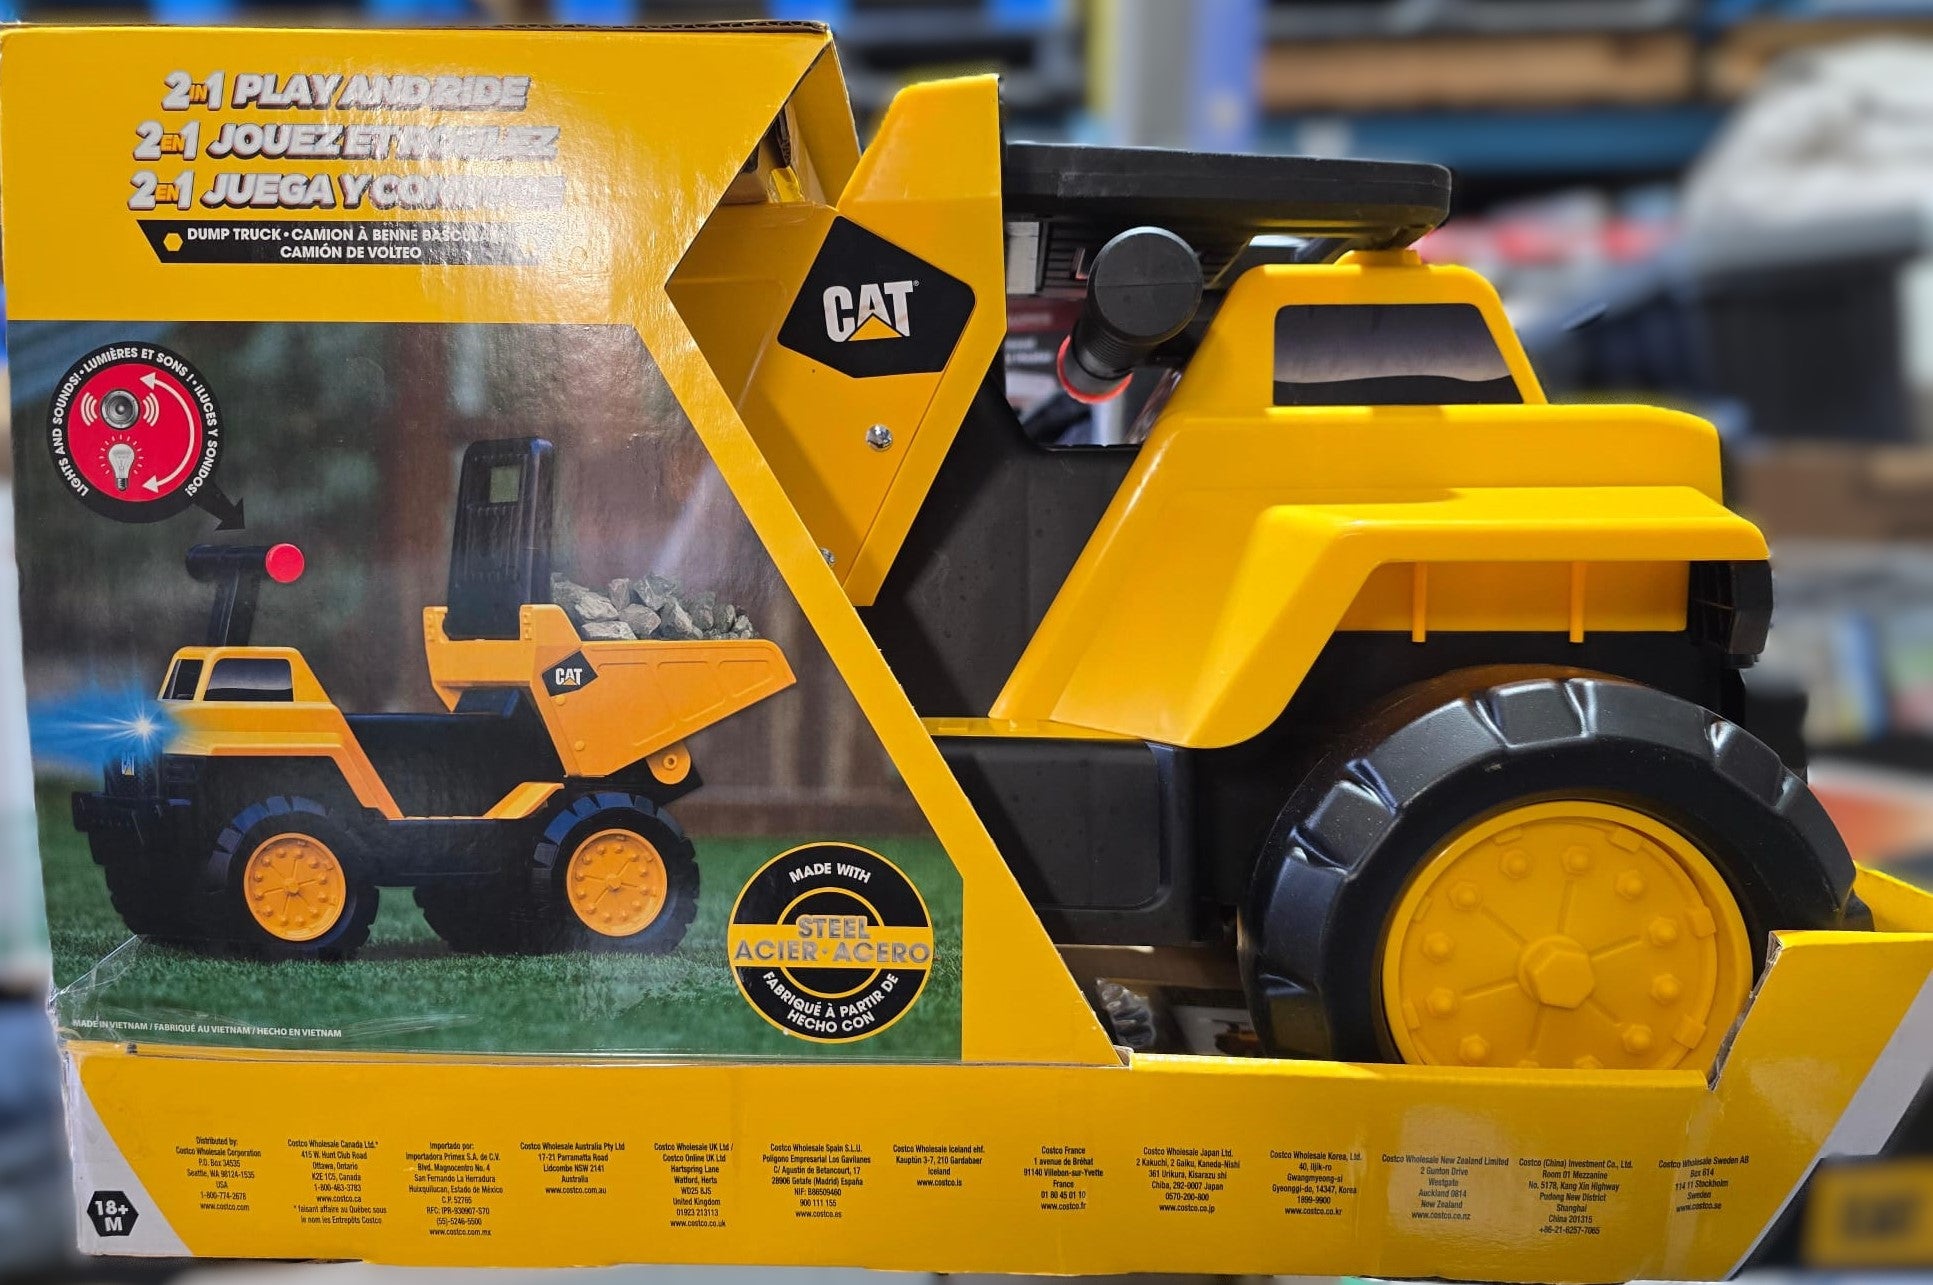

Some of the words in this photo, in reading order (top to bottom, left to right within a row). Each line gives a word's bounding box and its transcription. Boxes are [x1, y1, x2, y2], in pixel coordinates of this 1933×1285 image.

[231, 74, 343, 110] PLAY
[337, 74, 431, 110] AND
[431, 76, 531, 111] RIDE
[206, 123, 344, 159] JOUEZ
[342, 124, 401, 160] ET
[200, 173, 337, 209] JUEGA
[338, 174, 374, 210] Y
[187, 228, 230, 240] DUMP
[233, 228, 281, 241] TRUCK
[291, 228, 353, 241] CAMION
[357, 226, 368, 241] À
[372, 229, 418, 241] BENNE
[280, 243, 343, 258] CAMIÓN
[346, 246, 365, 258] DE
[369, 247, 421, 259] VOLTEO
[823, 280, 914, 343] CAT
[141, 348, 153, 360] ET
[84, 347, 138, 373] LUMIÈRES
[156, 352, 189, 377] SONS
[53, 373, 82, 425] SOUNDS!
[207, 428, 219, 437] Y
[52, 427, 65, 455] AND
[58, 460, 90, 496] LIGHTS
[555, 667, 583, 686] CAT
[789, 862, 832, 884] MADE
[837, 862, 872, 884] WITH
[797, 916, 871, 940] STEEL
[735, 940, 819, 961] ACIER
[832, 942, 931, 964] ACERO
[762, 971, 822, 1017] FABRIQUÉ
[825, 1003, 836, 1018] À
[840, 989, 885, 1018] PARTIR
[882, 973, 899, 993] DE
[787, 1010, 838, 1033] HECHO
[841, 1011, 875, 1033] CON
[72, 1019, 99, 1028] MADE
[100, 1020, 108, 1028] IN
[109, 1021, 148, 1030] VIETNAM
[154, 1022, 196, 1033] FABRIQUÉ
[197, 1025, 210, 1033] AU
[211, 1025, 251, 1035] VIETNAM
[257, 1027, 288, 1036] HECHO
[289, 1028, 301, 1036] EN
[301, 1029, 342, 1037] VIETNAM
[196, 1136, 228, 1145] Distributed
[176, 1146, 195, 1155] Costco
[196, 1147, 226, 1156] Wholesale
[227, 1148, 261, 1158] Corporation
[430, 1142, 460, 1151] Importado
[520, 1142, 541, 1150] Costco
[542, 1142, 573, 1150] Wholesale
[575, 1142, 602, 1150] Australia
[604, 1142, 613, 1152] Pty
[615, 1142, 625, 1150] Ltd
[719, 1143, 729, 1151] Ltd
[770, 1143, 791, 1151] Costco
[792, 1144, 824, 1152] Wholesale
[826, 1144, 843, 1153] Spain
[893, 1144, 914, 1152] Costco
[915, 1144, 947, 1153] Wholesale
[949, 1145, 971, 1153] Iceland
[1042, 1146, 1063, 1154] Costco
[1064, 1146, 1085, 1154] France
[557, 1153, 591, 1161] Parramatta
[592, 1153, 608, 1161] Road
[663, 1154, 684, 1162] Costco
[685, 1154, 704, 1162] Online
[706, 1154, 715, 1162] UK
[716, 1154, 726, 1162] Ltd
[1144, 1147, 1165, 1155] Costco
[1166, 1147, 1198, 1156] Wholesale
[1200, 1148, 1219, 1158] Japan
[336, 1162, 358, 1170] Ontario
[543, 1164, 572, 1172] Lidcombe
[574, 1164, 588, 1172] NSW
[1519, 1158, 1541, 1166] Costco
[1543, 1159, 1566, 1169] (China)
[1568, 1159, 1605, 1168] Investment
[209, 1169, 220, 1177] WA
[671, 1165, 703, 1174] Hartspring
[928, 1167, 950, 1175] Iceland
[1053, 1180, 1074, 1188] France
[1287, 1173, 1342, 1184] Gwangmyeong-si
[1687, 1190, 1711, 1200] Sweden
[694, 1197, 720, 1207] Kingdom
[1421, 1199, 1435, 1208] New
[1437, 1200, 1462, 1208] Zealand
[94, 1200, 129, 1216] 18+
[1556, 1203, 1587, 1213] Shanghai
[1548, 1214, 1567, 1222] China
[105, 1216, 123, 1232] M
